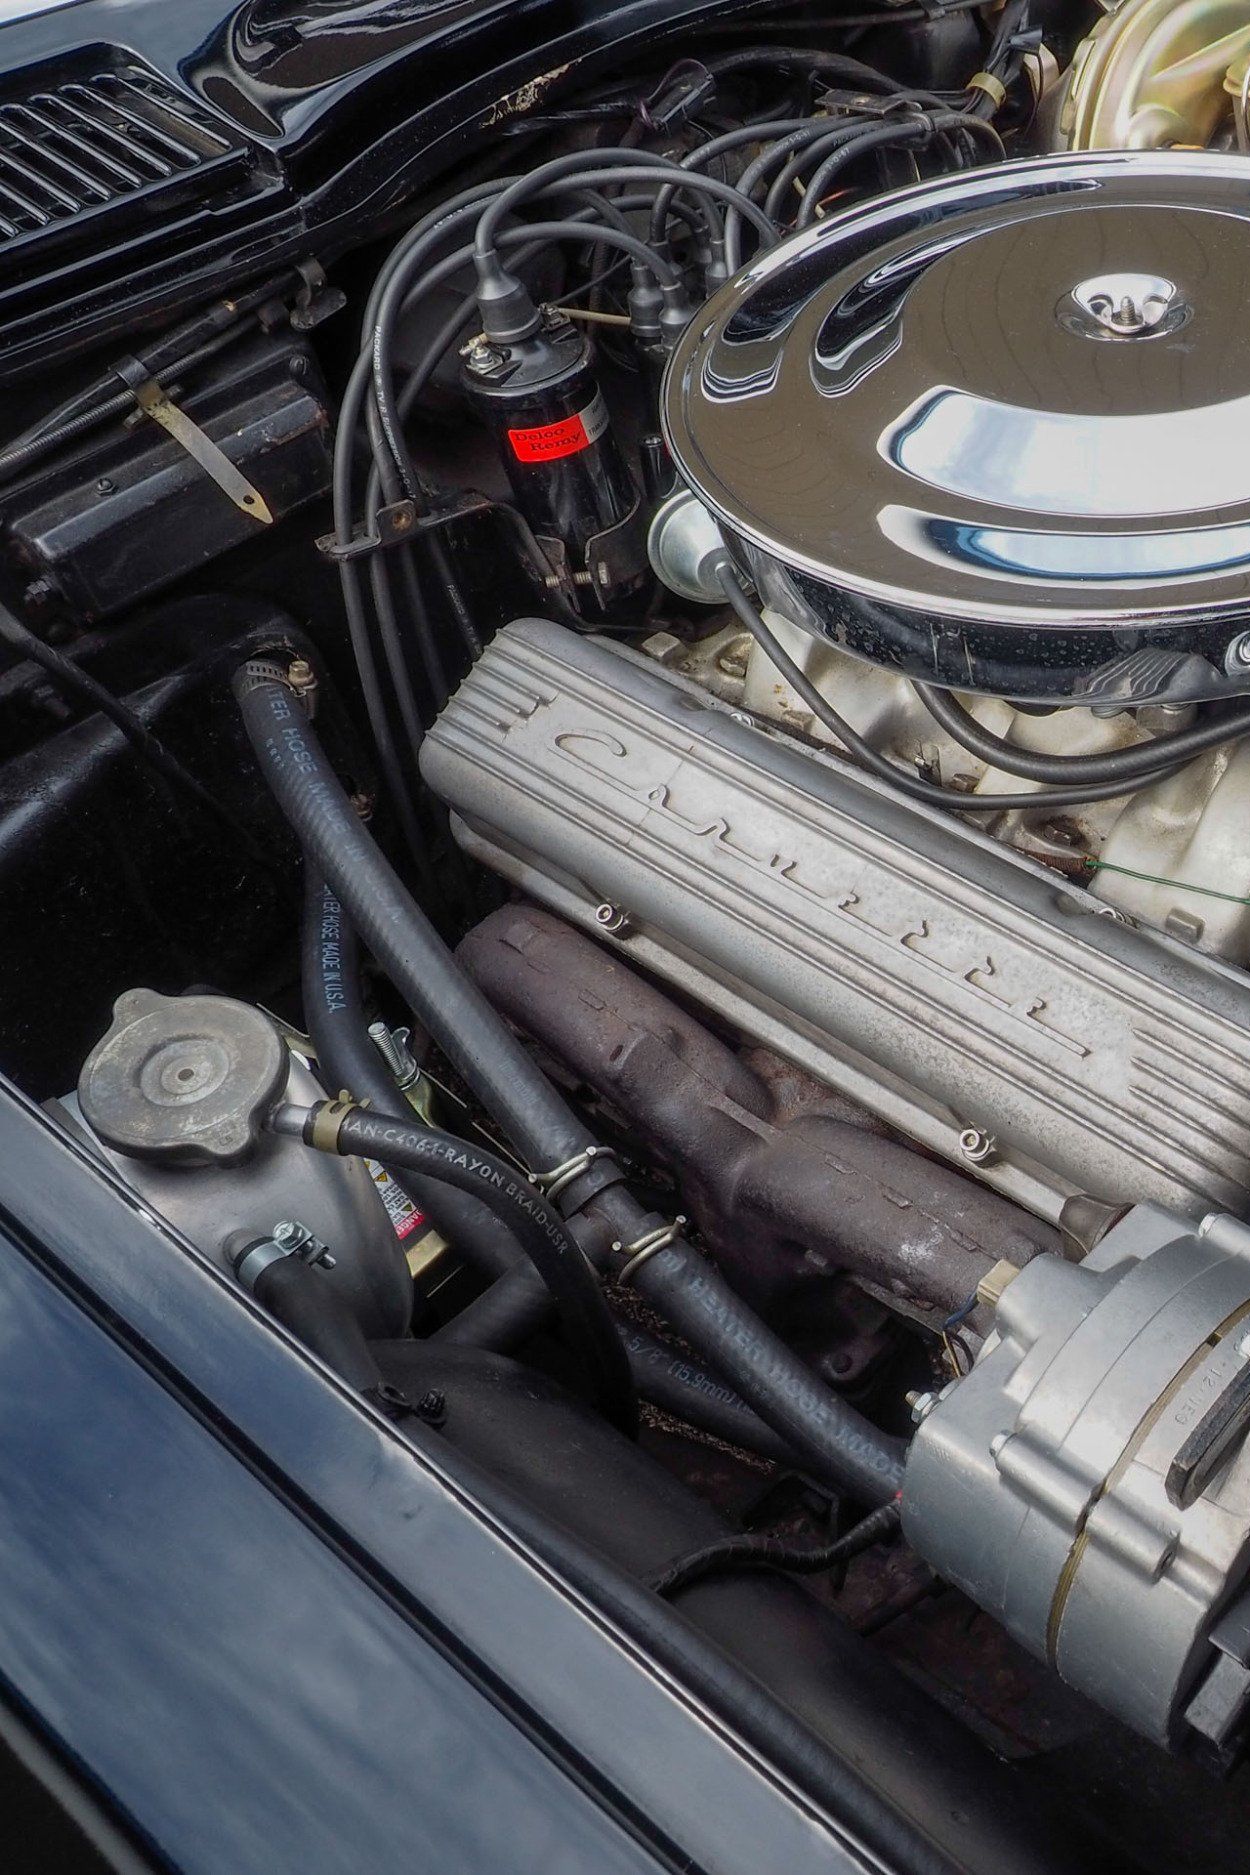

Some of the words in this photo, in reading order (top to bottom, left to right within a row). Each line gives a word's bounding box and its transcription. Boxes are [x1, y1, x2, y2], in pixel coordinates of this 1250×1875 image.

[514, 426, 564, 443] Delco
[529, 432, 580, 451] Remy
[281, 724, 318, 777] HOSE
[307, 778, 352, 836] MADE
[321, 915, 340, 940] HOSE
[322, 941, 341, 969] MADE
[323, 971, 342, 982] IN
[324, 983, 346, 1014] U.S.A.
